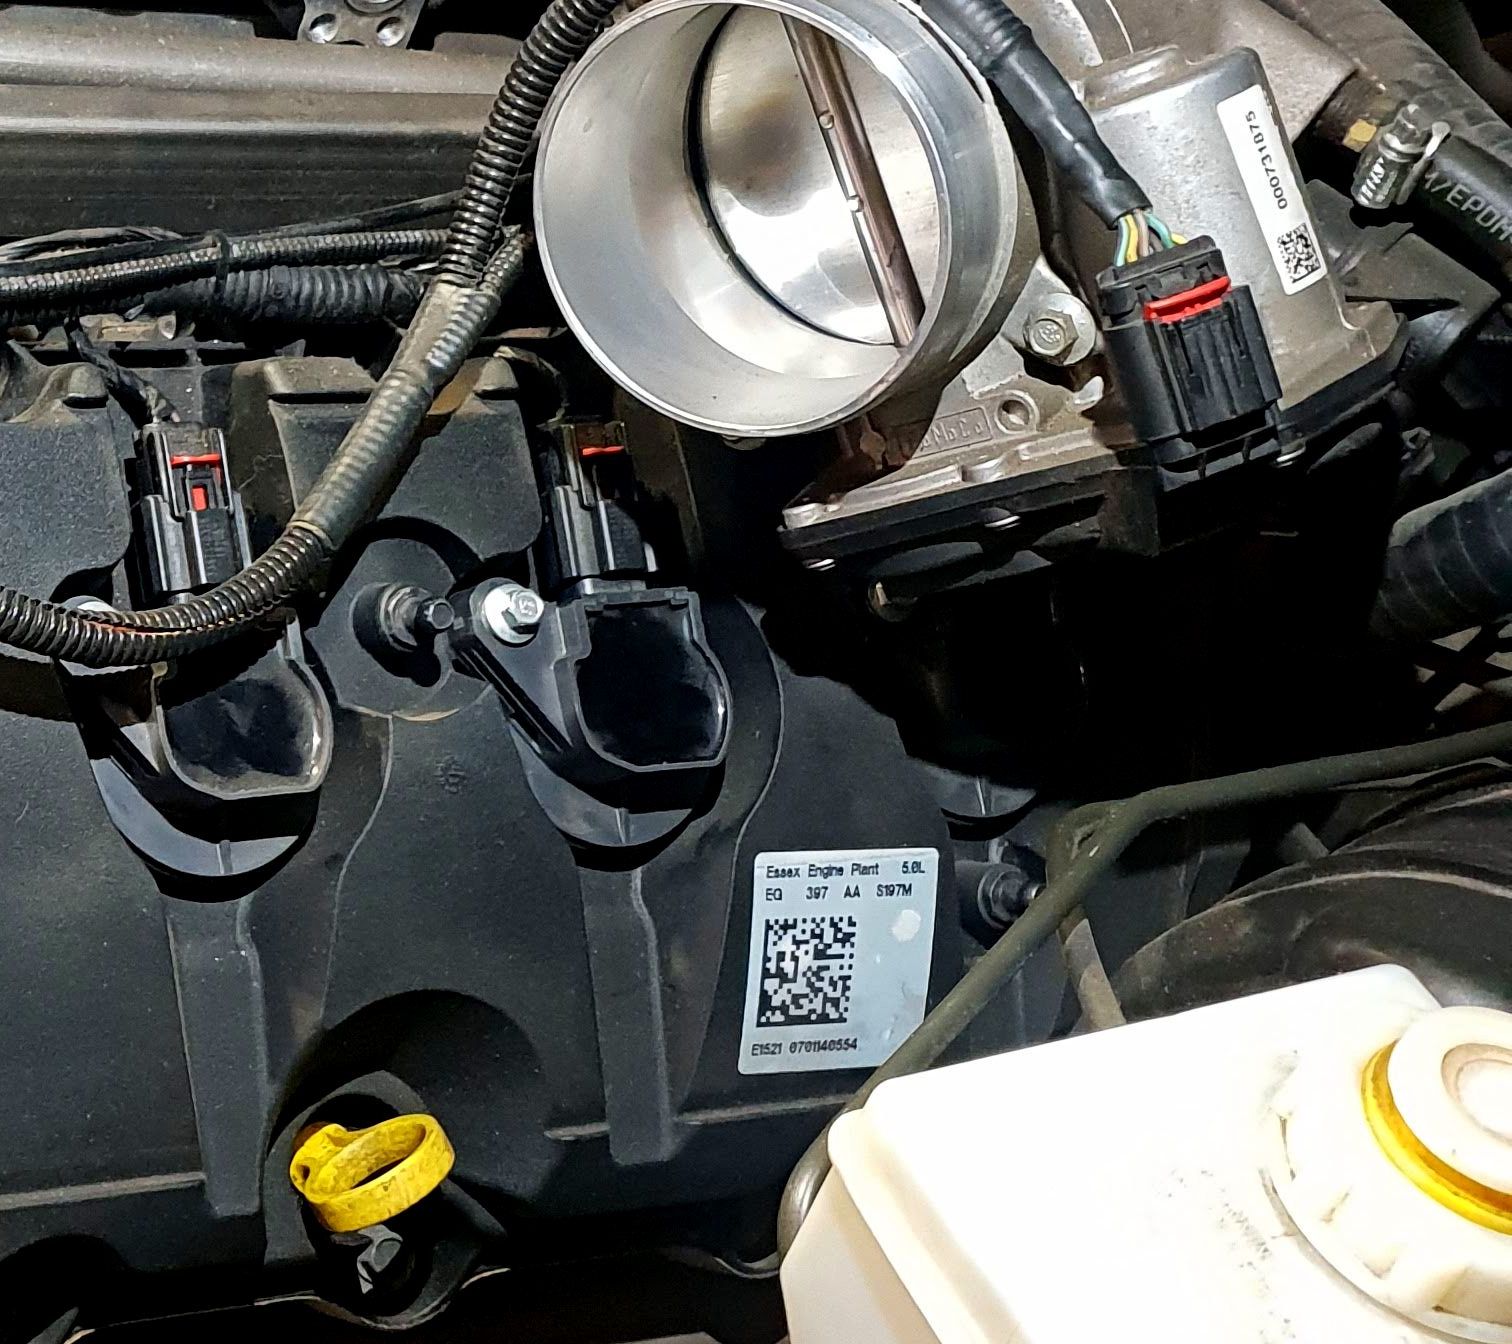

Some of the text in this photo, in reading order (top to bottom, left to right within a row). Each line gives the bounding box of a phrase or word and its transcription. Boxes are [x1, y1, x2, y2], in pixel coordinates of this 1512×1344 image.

[1244, 110, 1289, 210] 000731875
[766, 860, 926, 879] Essex Engine Plant 5.0L
[765, 883, 912, 901] EQ 397 AA S197M
